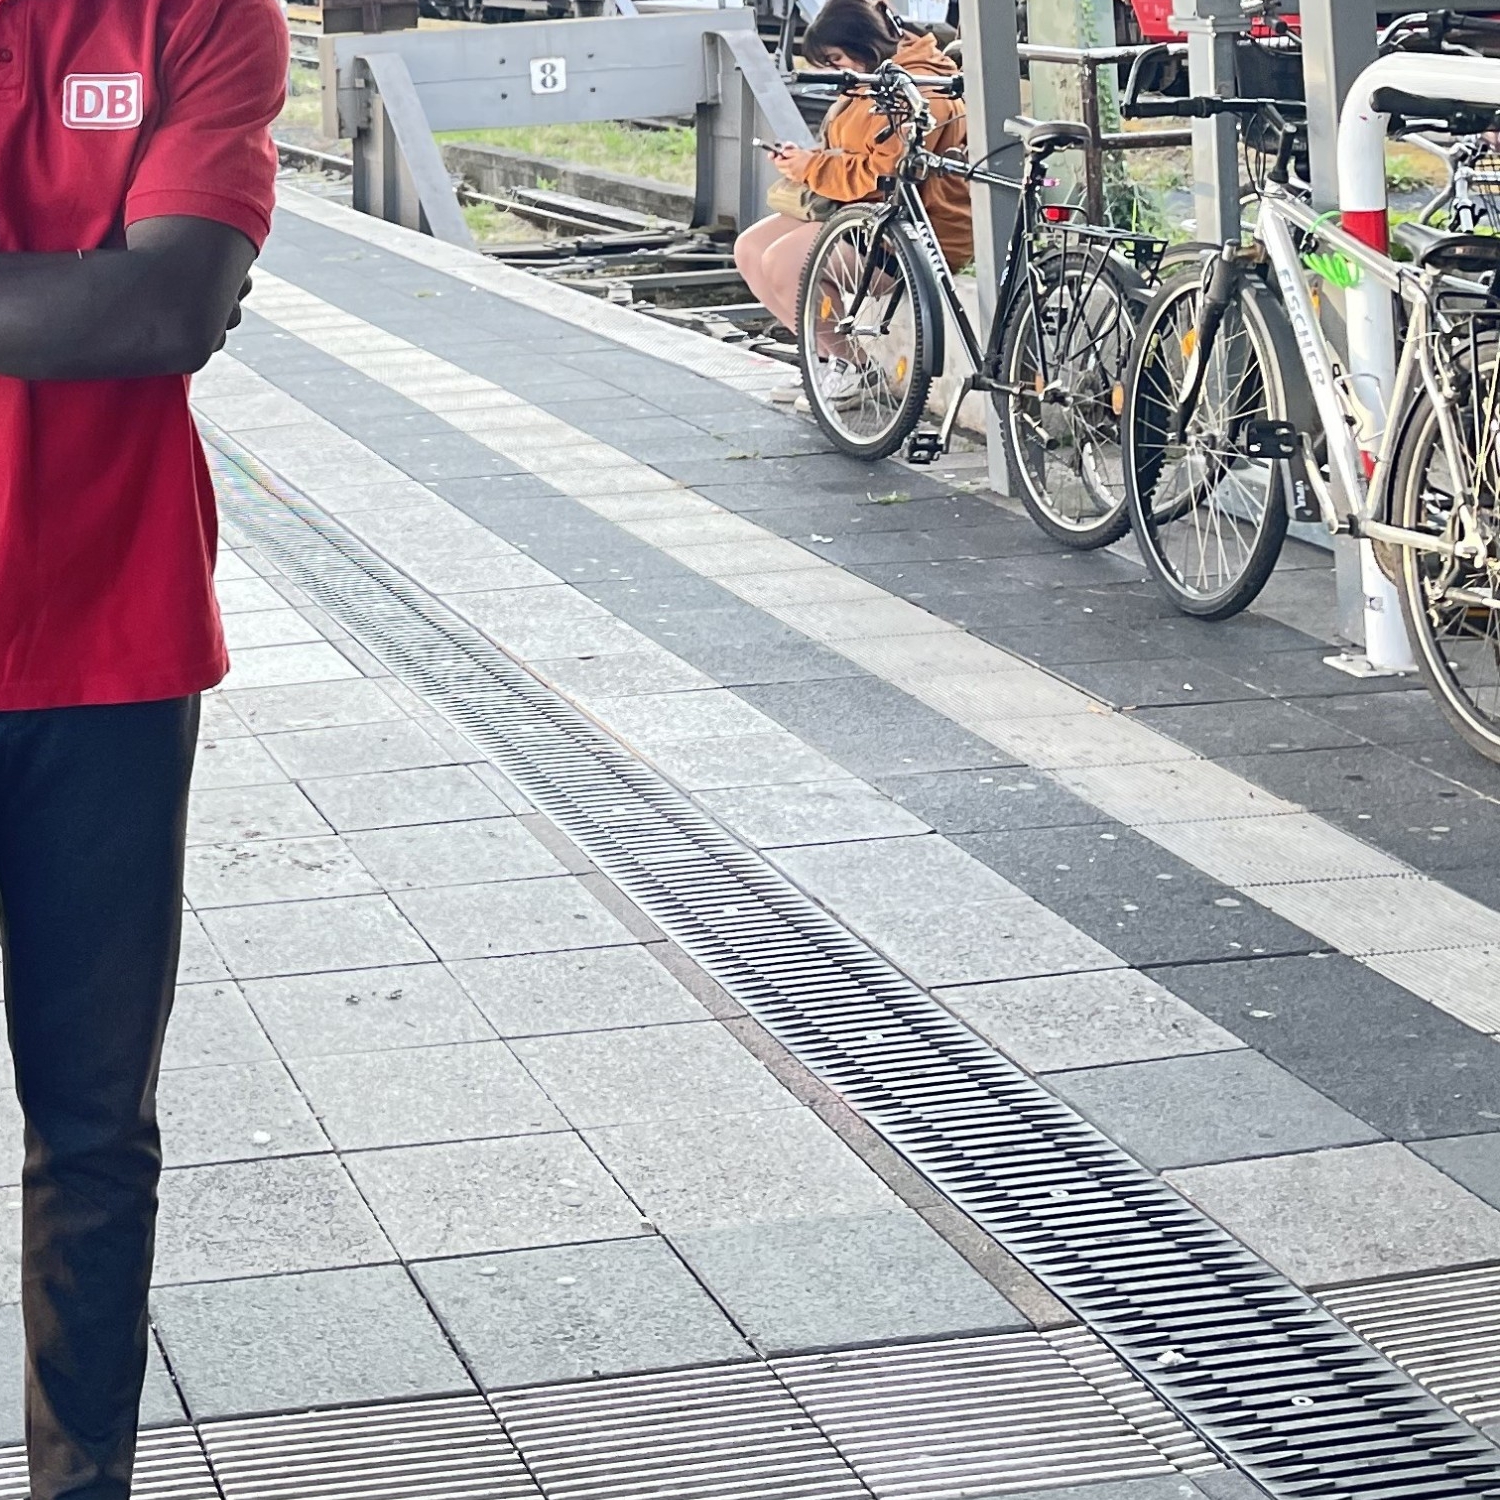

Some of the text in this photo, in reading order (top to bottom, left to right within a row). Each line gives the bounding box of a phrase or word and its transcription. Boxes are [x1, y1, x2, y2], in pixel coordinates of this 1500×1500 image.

[540, 62, 558, 89] 8
[75, 84, 134, 119] DB
[1278, 268, 1326, 387] FISCHER
